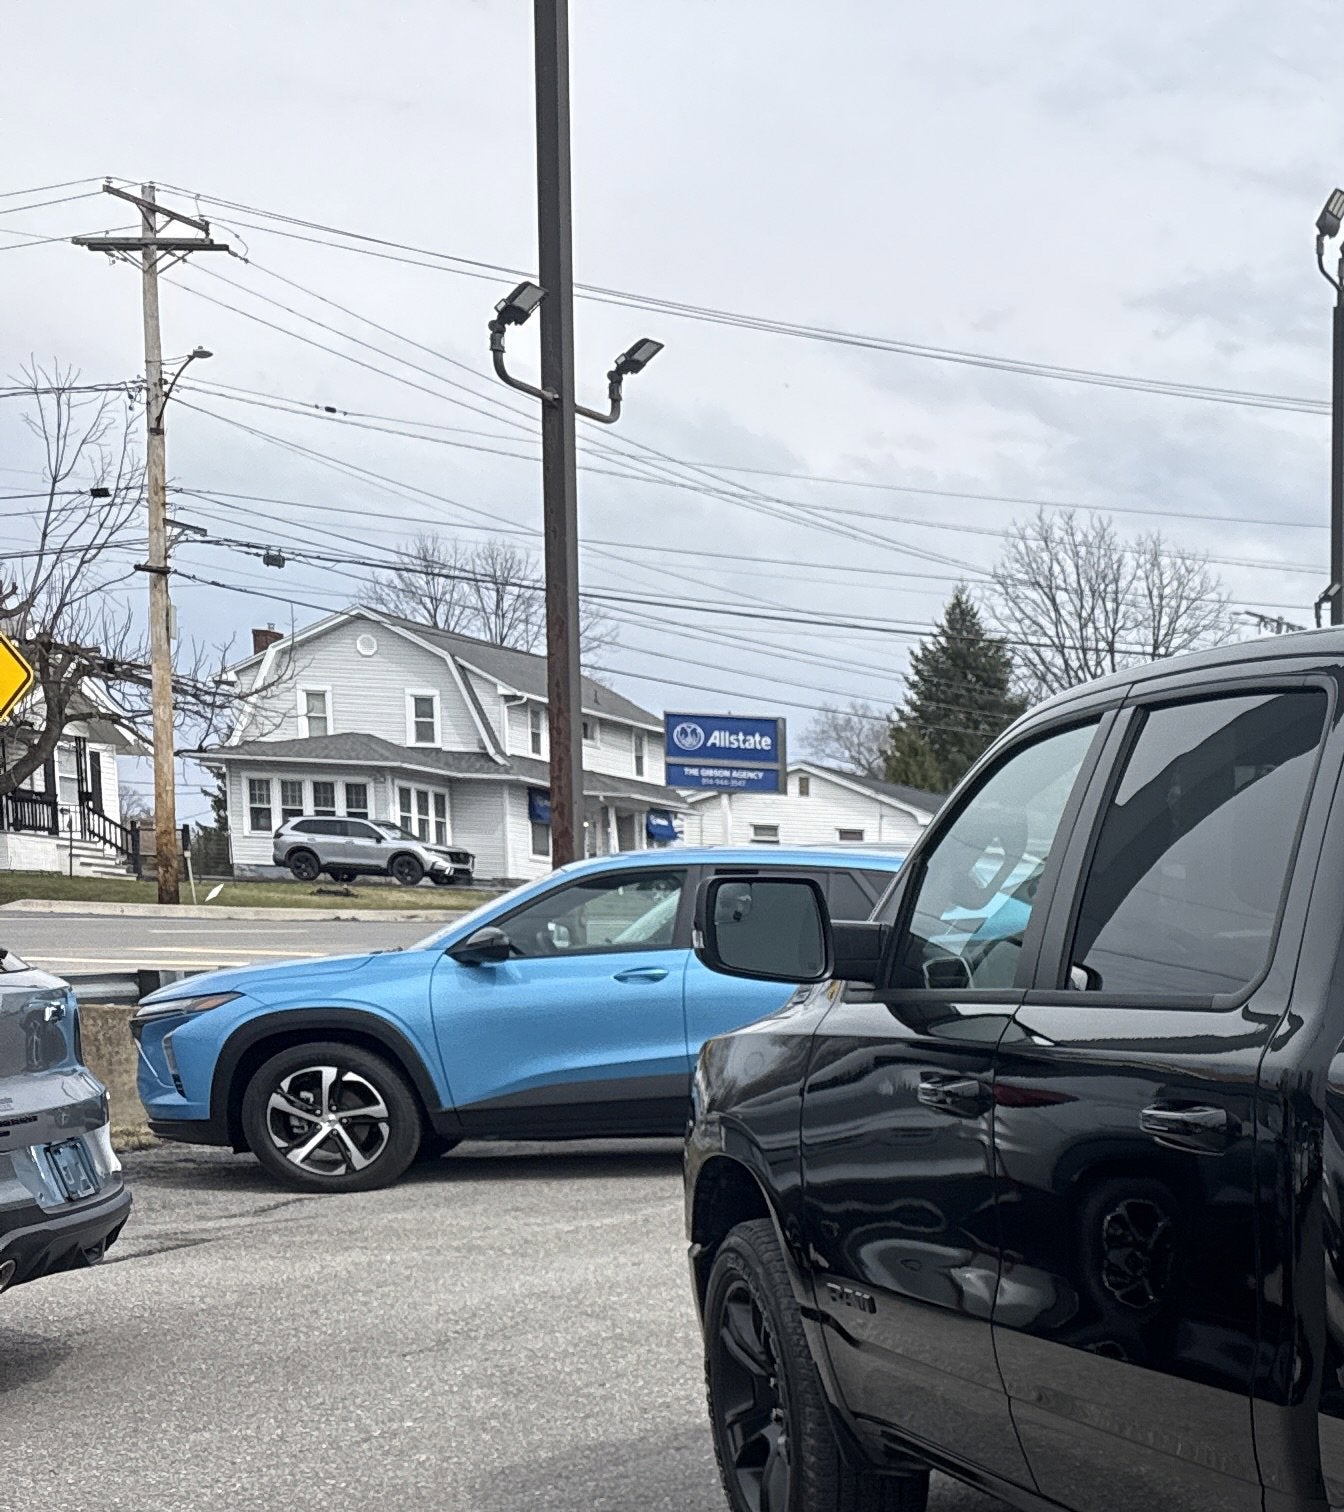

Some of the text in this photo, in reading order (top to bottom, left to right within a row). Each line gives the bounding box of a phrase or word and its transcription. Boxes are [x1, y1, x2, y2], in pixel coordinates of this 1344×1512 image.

[706, 730, 772, 750] Allstate
[683, 767, 699, 777] THE
[731, 769, 764, 780] AGENCY
[826, 1282, 877, 1314] RAM
